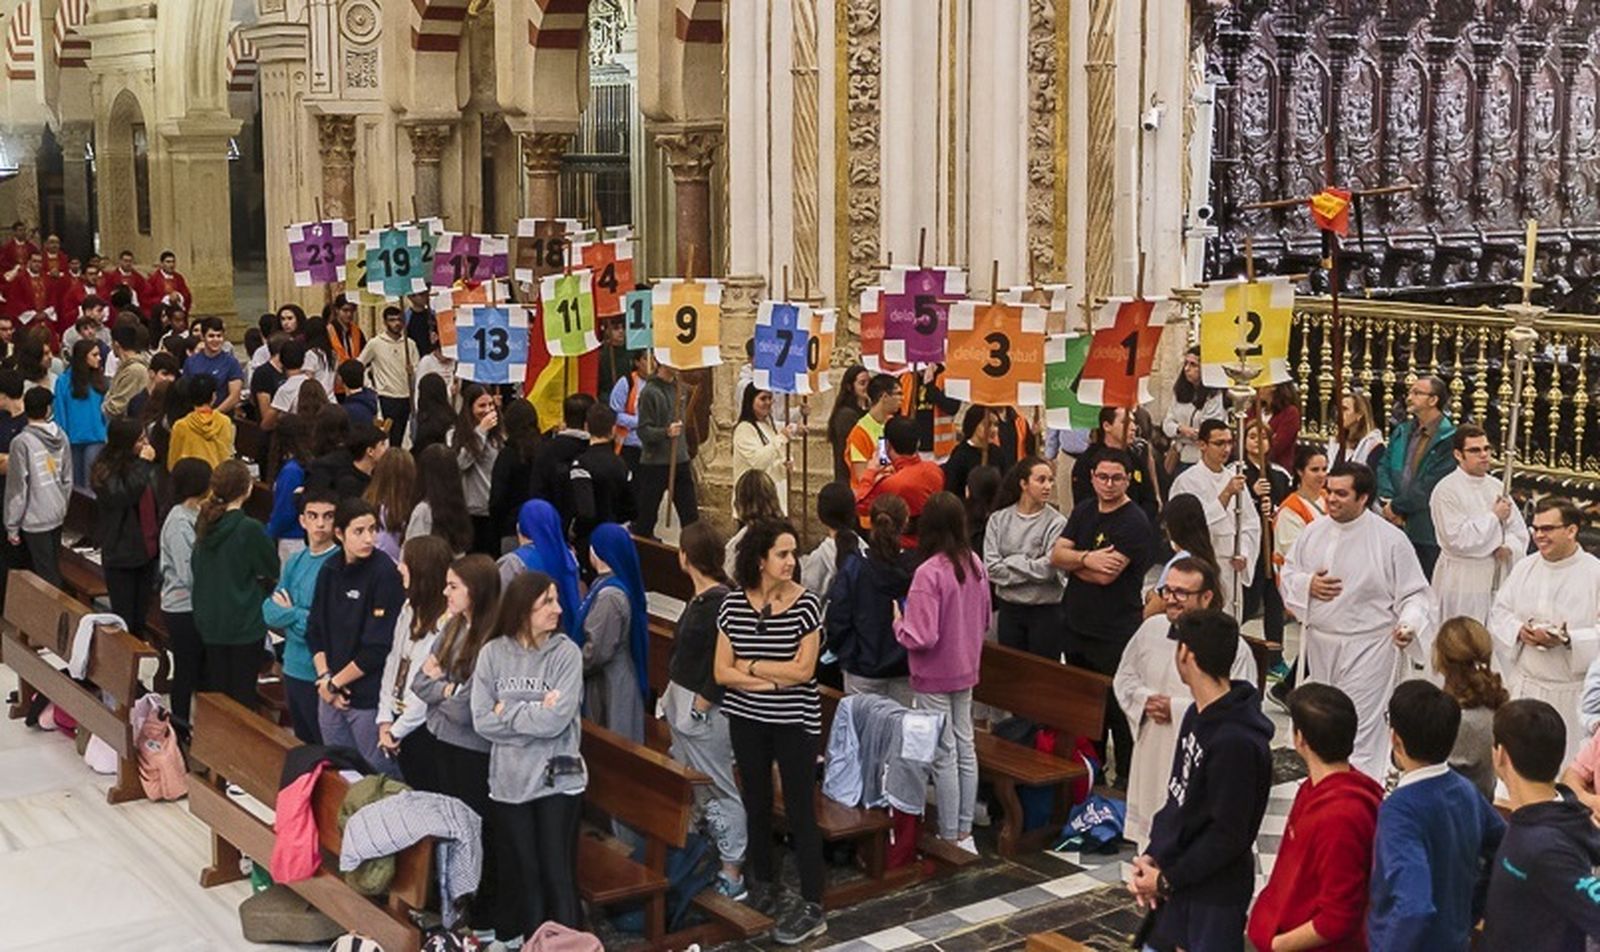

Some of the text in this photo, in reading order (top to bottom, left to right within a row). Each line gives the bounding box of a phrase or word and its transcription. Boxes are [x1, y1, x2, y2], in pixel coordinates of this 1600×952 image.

[306, 242, 335, 266] 23
[378, 247, 411, 278] 19
[450, 253, 480, 284] 17
[533, 238, 564, 268] 18
[598, 262, 618, 294] 4
[556, 297, 581, 333] 11
[630, 299, 650, 330] 1
[676, 305, 698, 344] 9
[914, 295, 938, 337] 5
[473, 327, 510, 362] 13
[775, 329, 794, 368] 7
[1233, 311, 1263, 357] 2
[981, 331, 1011, 378] 3
[1120, 330, 1139, 377] 1
